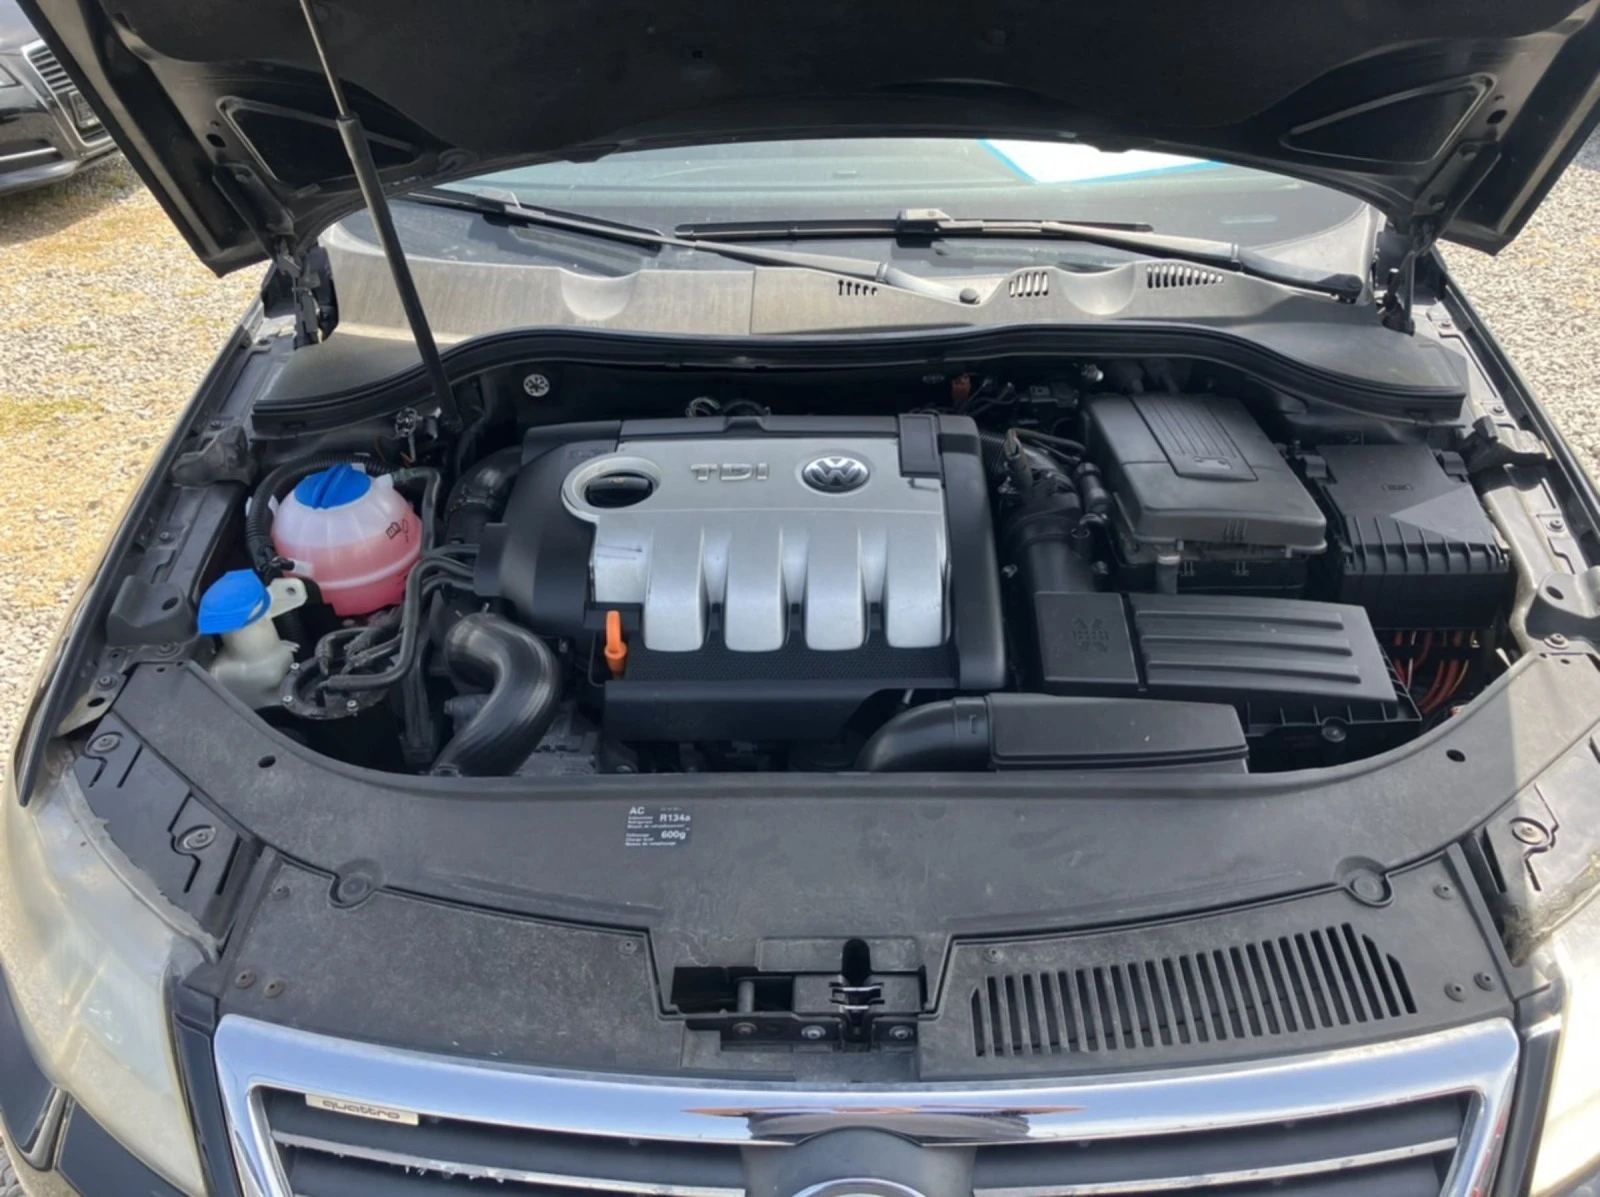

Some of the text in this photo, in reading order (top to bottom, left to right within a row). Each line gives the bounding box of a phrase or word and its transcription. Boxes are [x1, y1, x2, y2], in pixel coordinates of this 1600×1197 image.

[690, 462, 769, 481] TDI
[629, 806, 645, 815] AC
[660, 830, 686, 840] 600g
[322, 1100, 401, 1120] quattro
